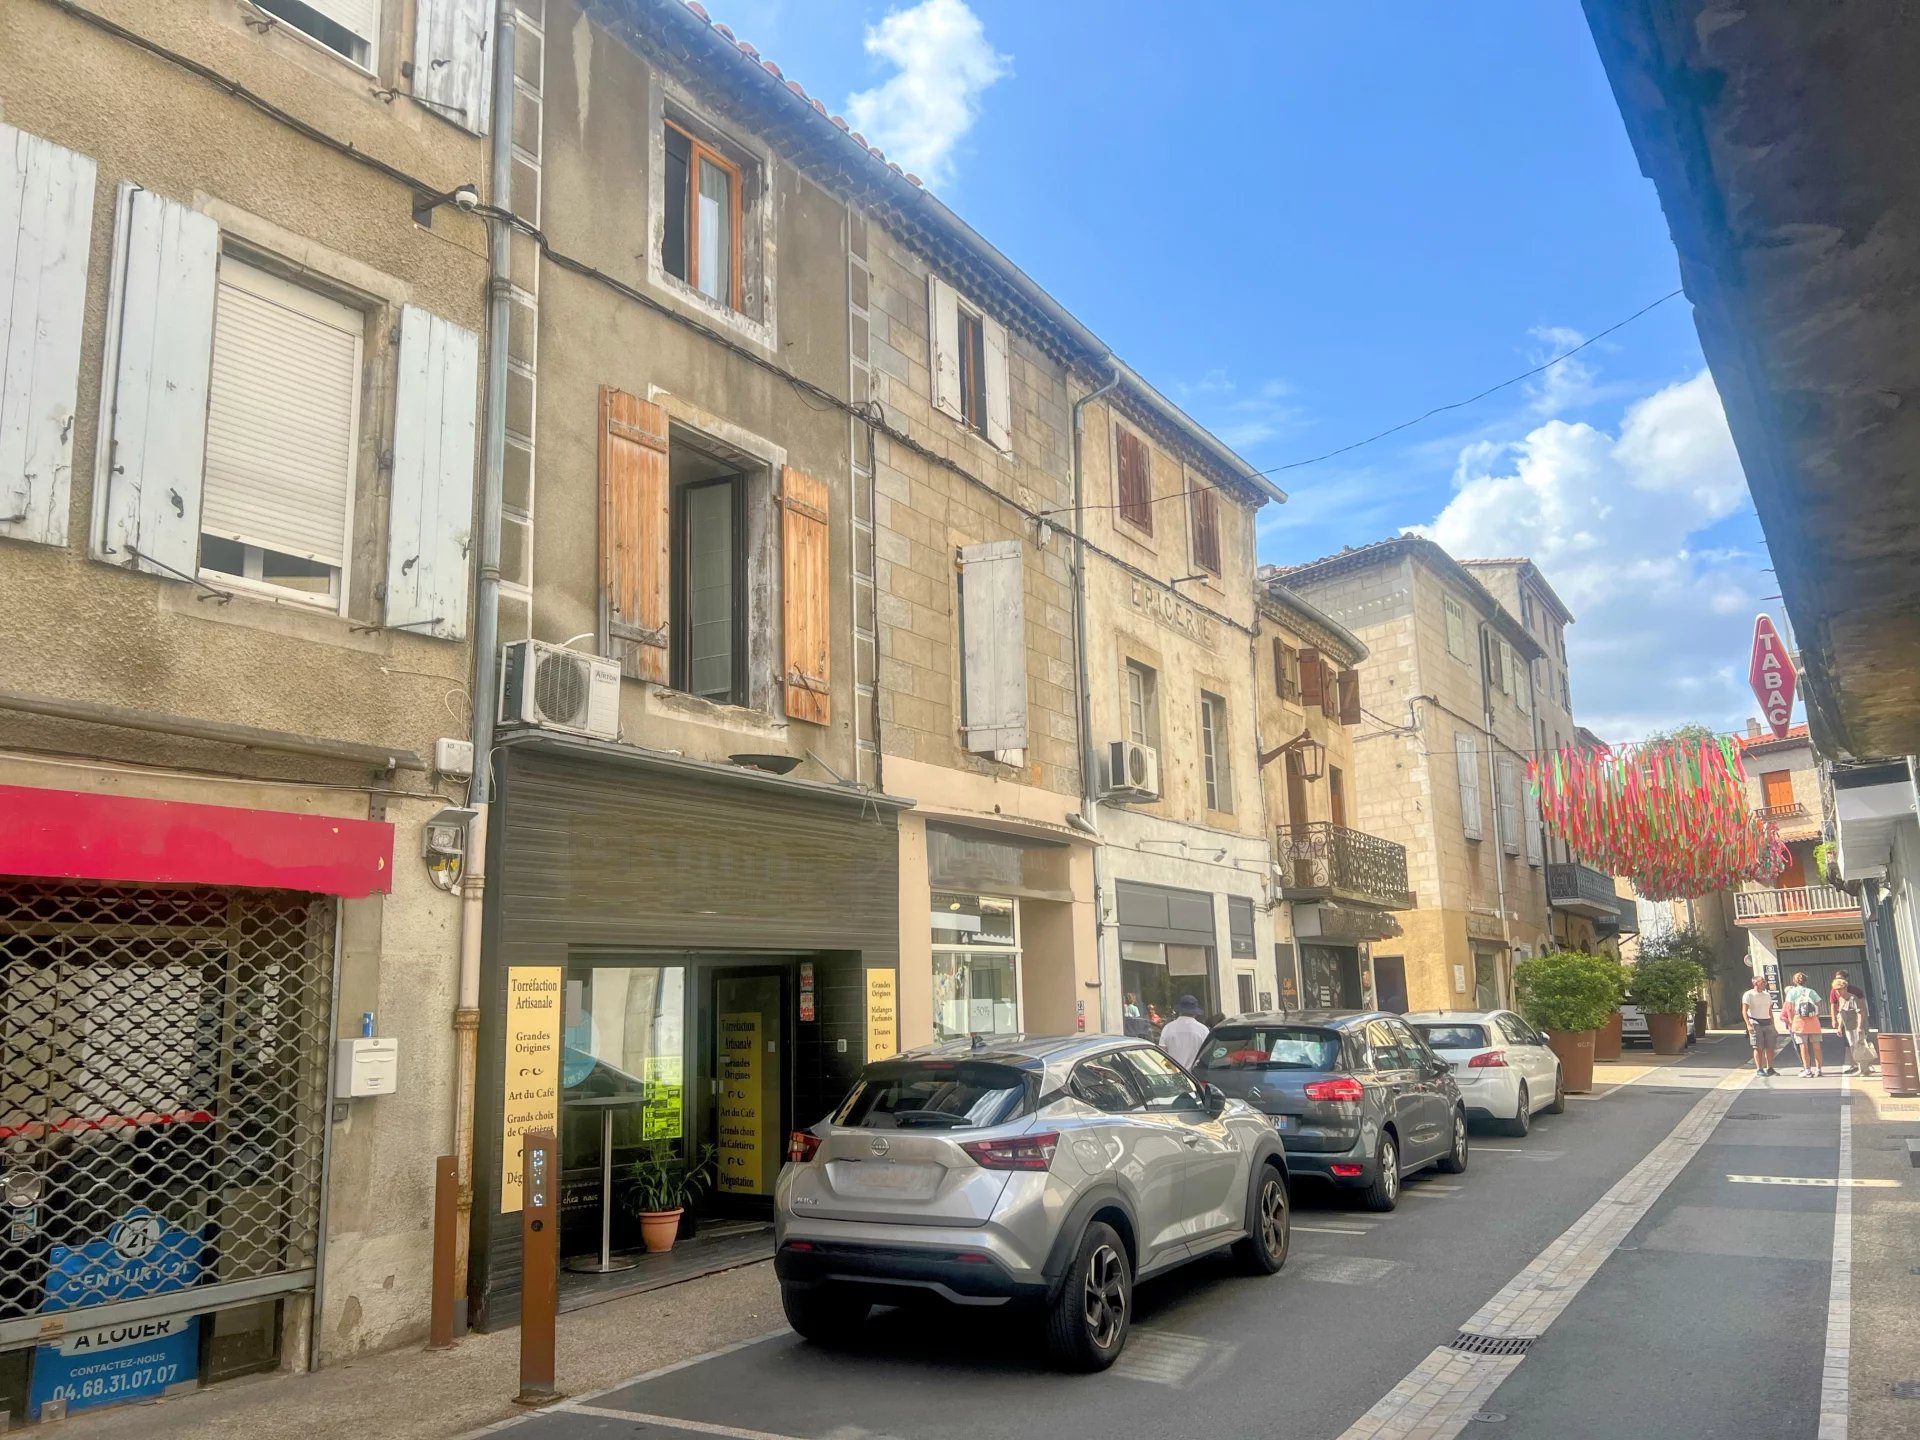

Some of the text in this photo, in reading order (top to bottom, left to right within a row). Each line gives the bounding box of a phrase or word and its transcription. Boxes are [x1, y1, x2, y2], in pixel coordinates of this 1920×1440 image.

[1131, 577, 1210, 641] EPICERIE
[1759, 633, 1788, 725] TABAC
[1780, 933, 1832, 944] DIAGNOSTIC
[511, 978, 557, 992] Torréfaction
[871, 981, 891, 989] Grandes
[871, 990, 891, 999] Origines
[515, 995, 553, 1009] Artisanale
[516, 1031, 551, 1041] Grandes
[515, 1043, 551, 1055] Origines
[508, 1087, 555, 1101] Art du Café
[507, 1111, 554, 1124] Grands choix
[720, 1107, 730, 1117] Art
[731, 1107, 740, 1117] du
[507, 1127, 517, 1137] de
[70, 1352, 167, 1378] CONTACTEZ-NOUS
[52, 1363, 178, 1401] 04.68.31.07.07
